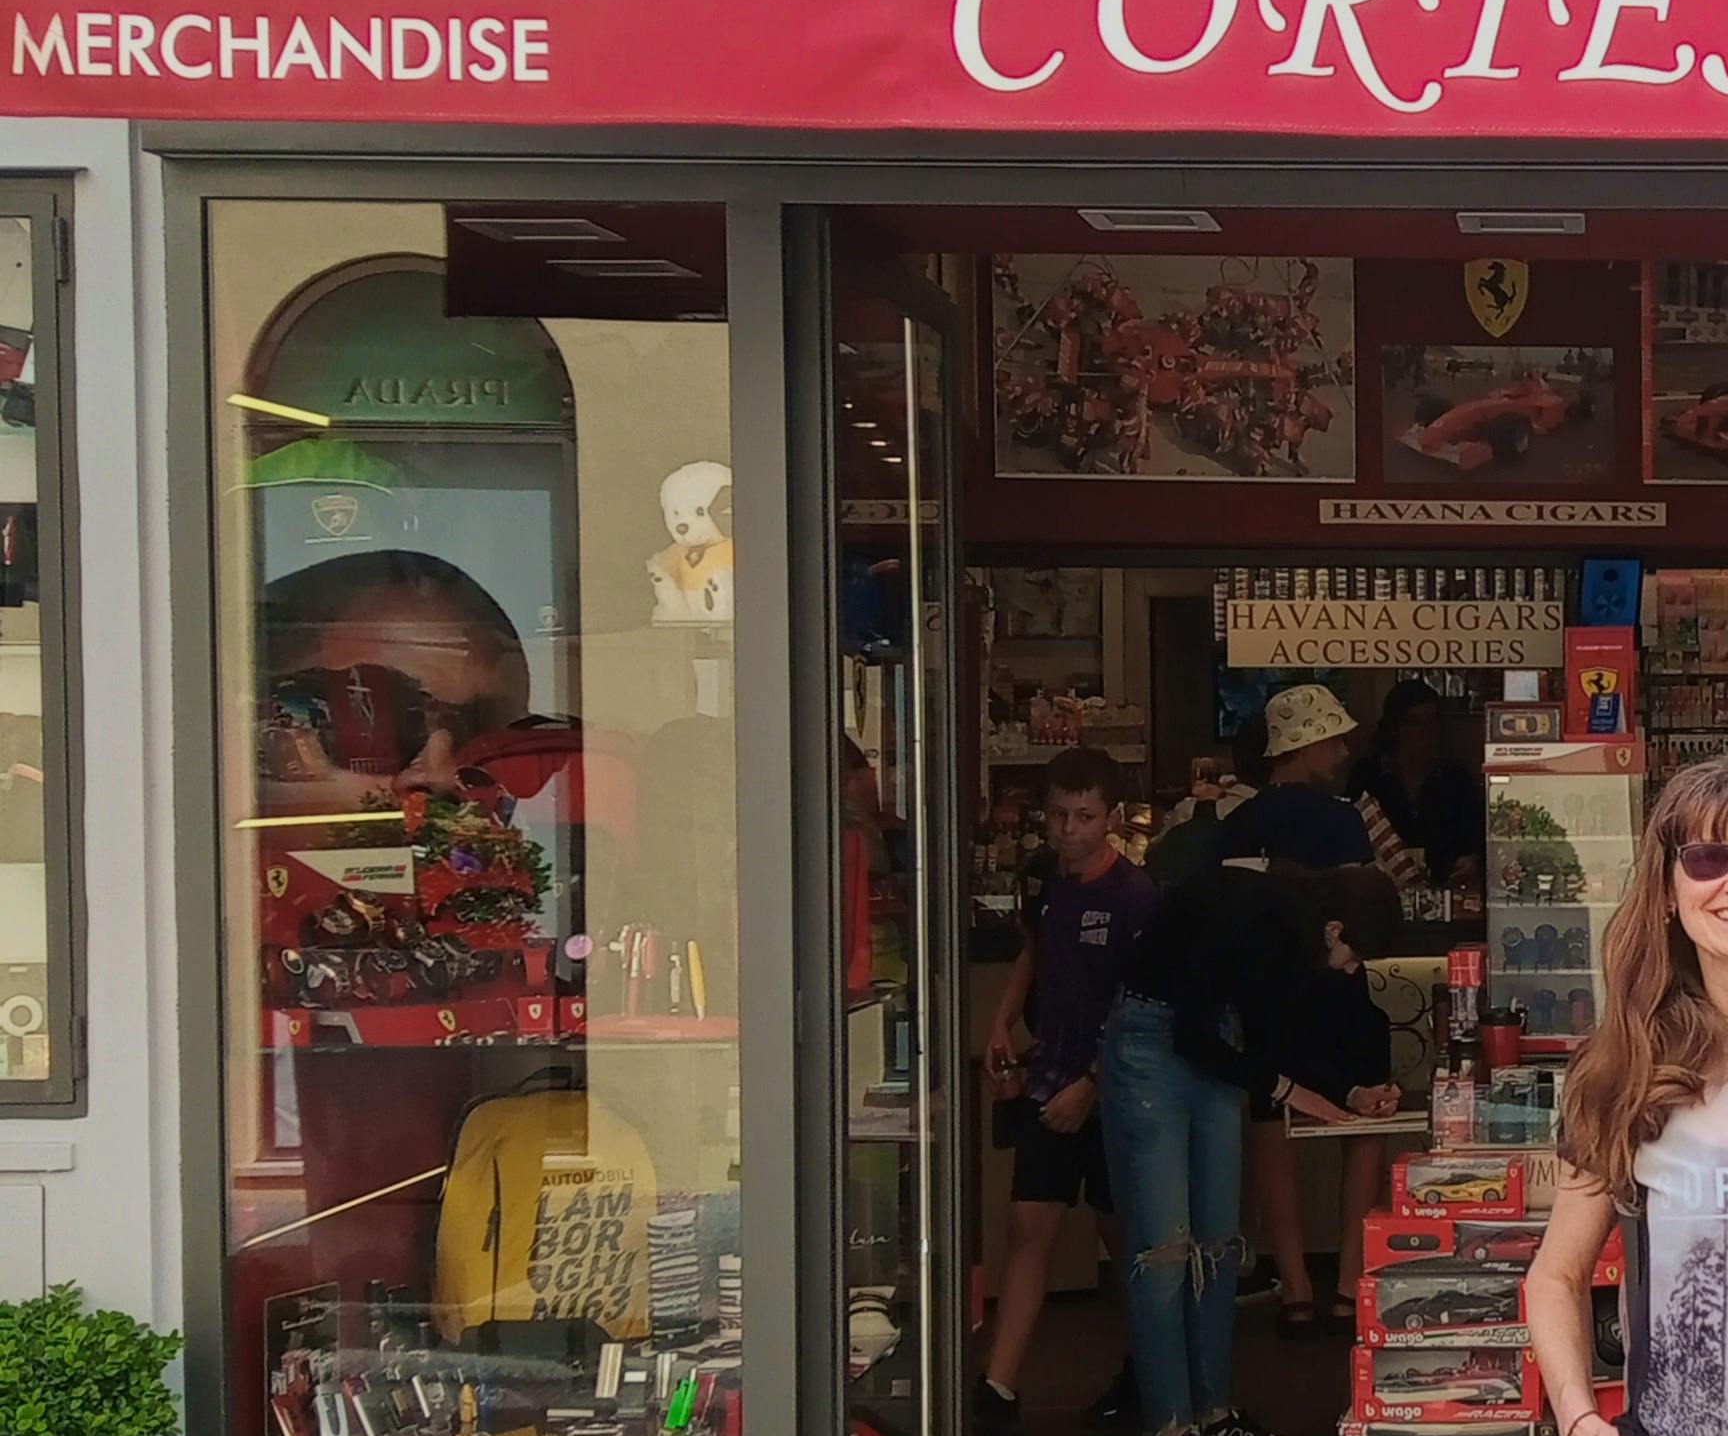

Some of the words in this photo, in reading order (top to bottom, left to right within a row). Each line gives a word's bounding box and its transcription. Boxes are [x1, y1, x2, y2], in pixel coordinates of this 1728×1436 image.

[12, 12, 550, 82] MERCHANDISE
[1330, 501, 1495, 521] HAVANA
[1505, 503, 1658, 522] CIGARS
[1231, 603, 1398, 631] HAVANA
[1411, 602, 1563, 632] CIGARS
[1269, 639, 1527, 666] ACCESSORIES
[542, 1168, 635, 1186] AUTOMOBILI
